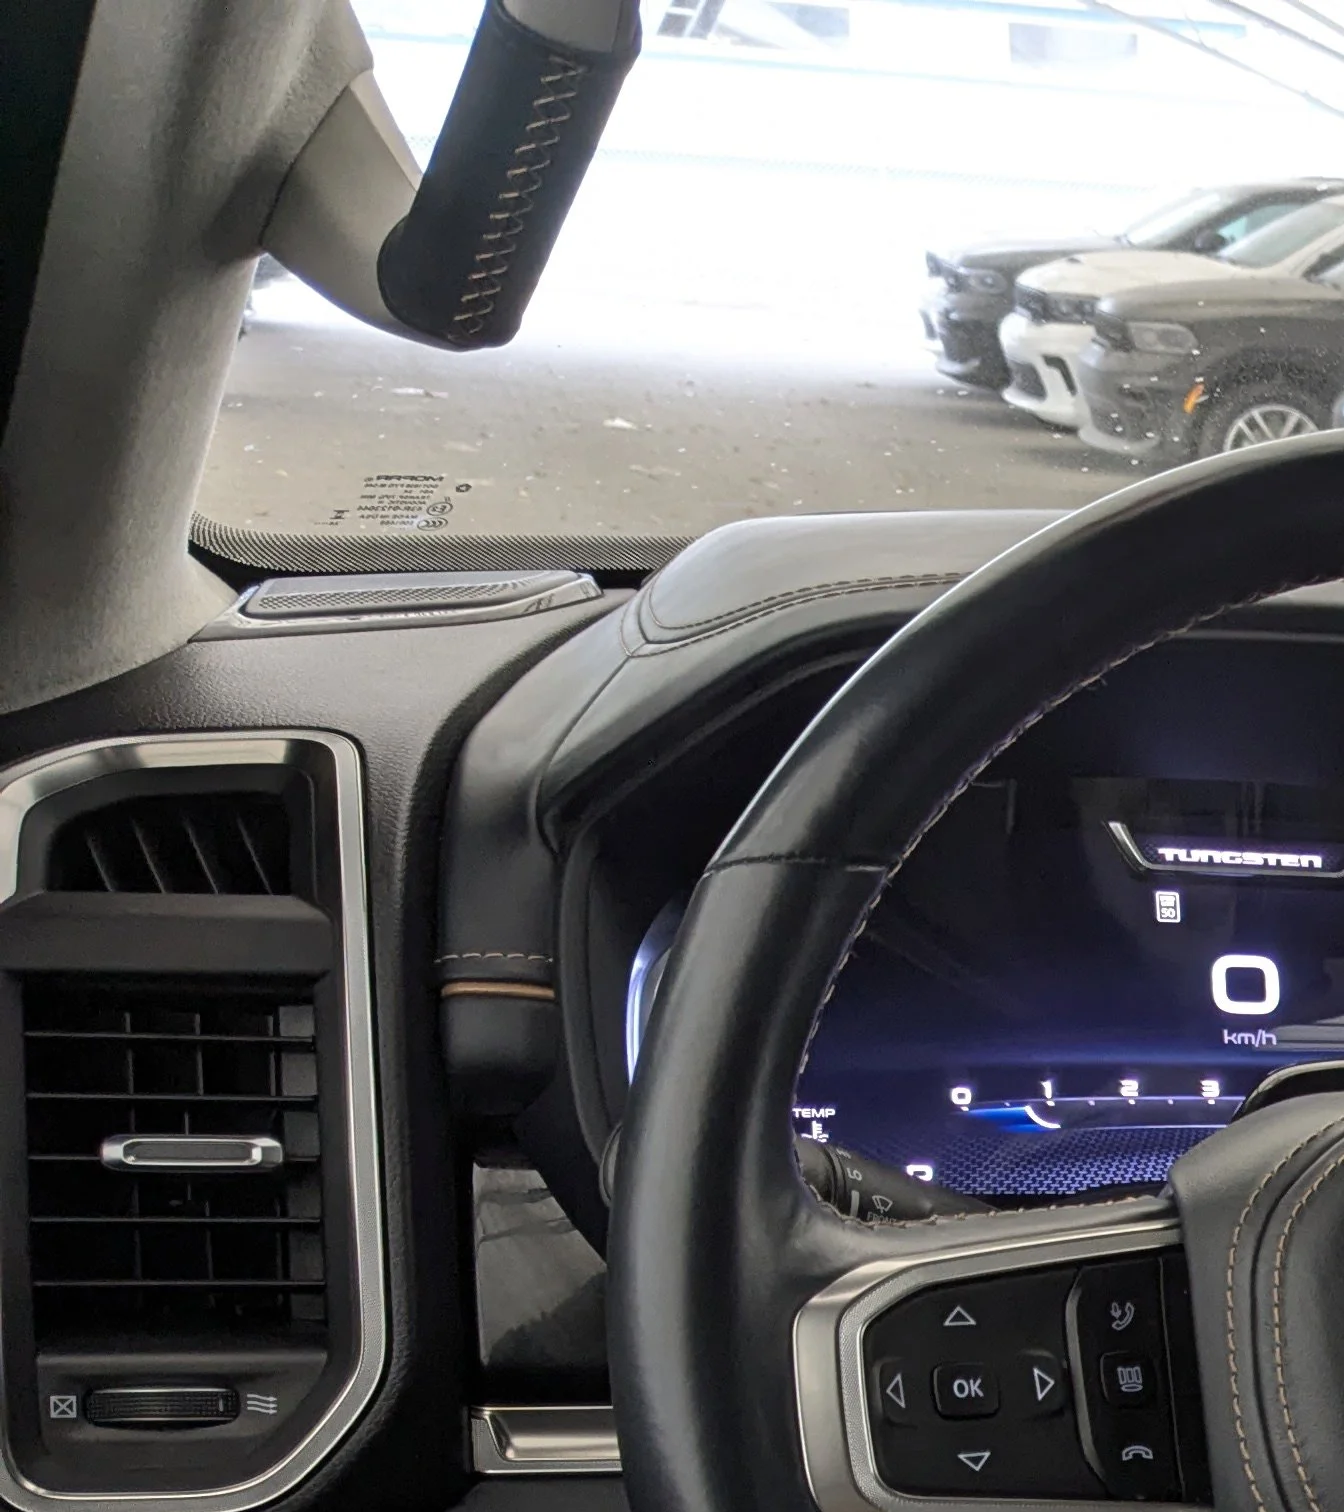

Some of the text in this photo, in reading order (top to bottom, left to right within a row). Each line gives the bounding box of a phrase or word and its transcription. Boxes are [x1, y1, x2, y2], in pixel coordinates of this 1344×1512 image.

[1157, 847, 1322, 868] TUNGSTEN
[1211, 953, 1280, 1015] 0
[1223, 1028, 1277, 1048] km/h
[951, 1079, 1220, 1105] 0 1 2 3
[792, 1108, 836, 1119] TEMP
[953, 1378, 984, 1398] OK
